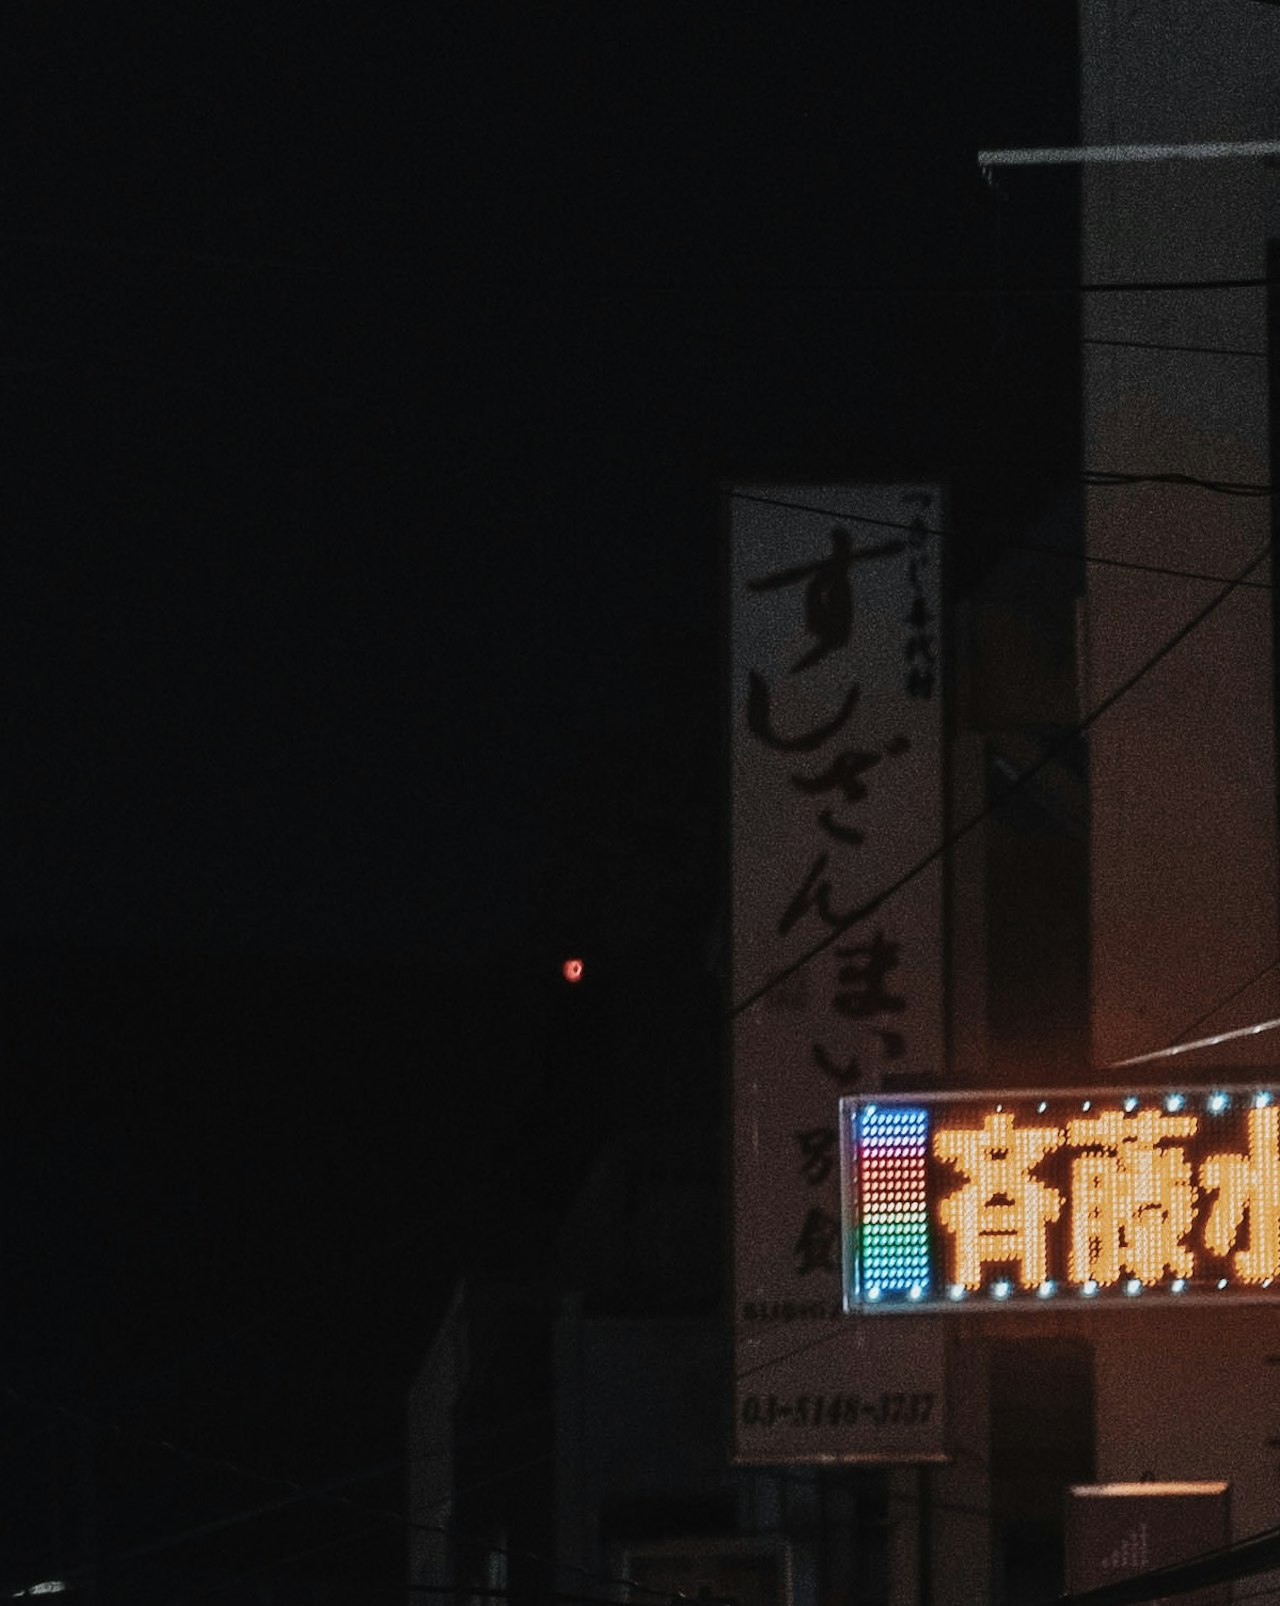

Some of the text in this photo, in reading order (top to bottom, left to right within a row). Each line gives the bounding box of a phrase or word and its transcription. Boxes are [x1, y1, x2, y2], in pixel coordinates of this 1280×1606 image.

[746, 528, 910, 1086] すしざんまい
